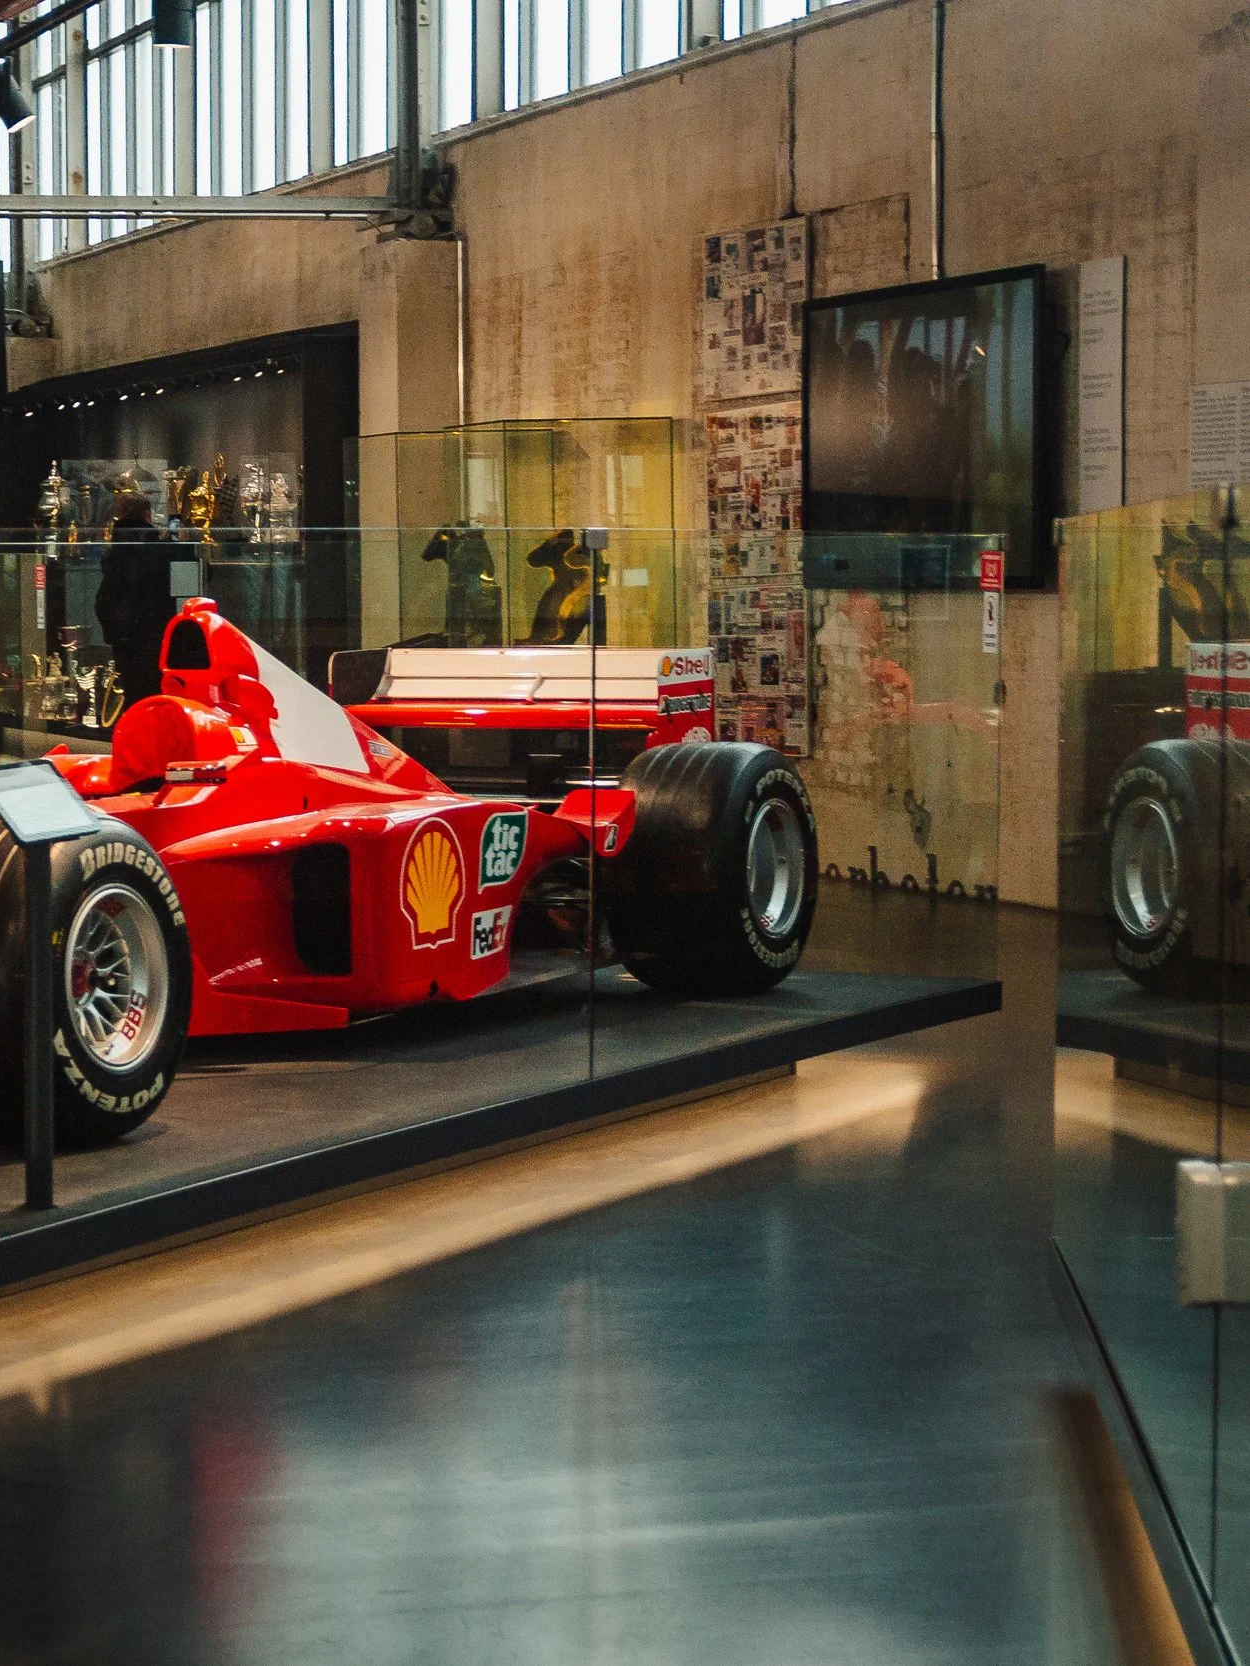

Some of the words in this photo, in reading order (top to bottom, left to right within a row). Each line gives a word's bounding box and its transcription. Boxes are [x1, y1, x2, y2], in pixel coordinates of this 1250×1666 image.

[675, 655, 710, 676] Shell
[492, 816, 520, 851] tic
[485, 843, 517, 877] tac
[79, 842, 186, 926] BRIDGESTONE
[473, 911, 506, 956] FedEx
[121, 990, 148, 1041] BBS
[53, 1026, 164, 1113] POTENZA
